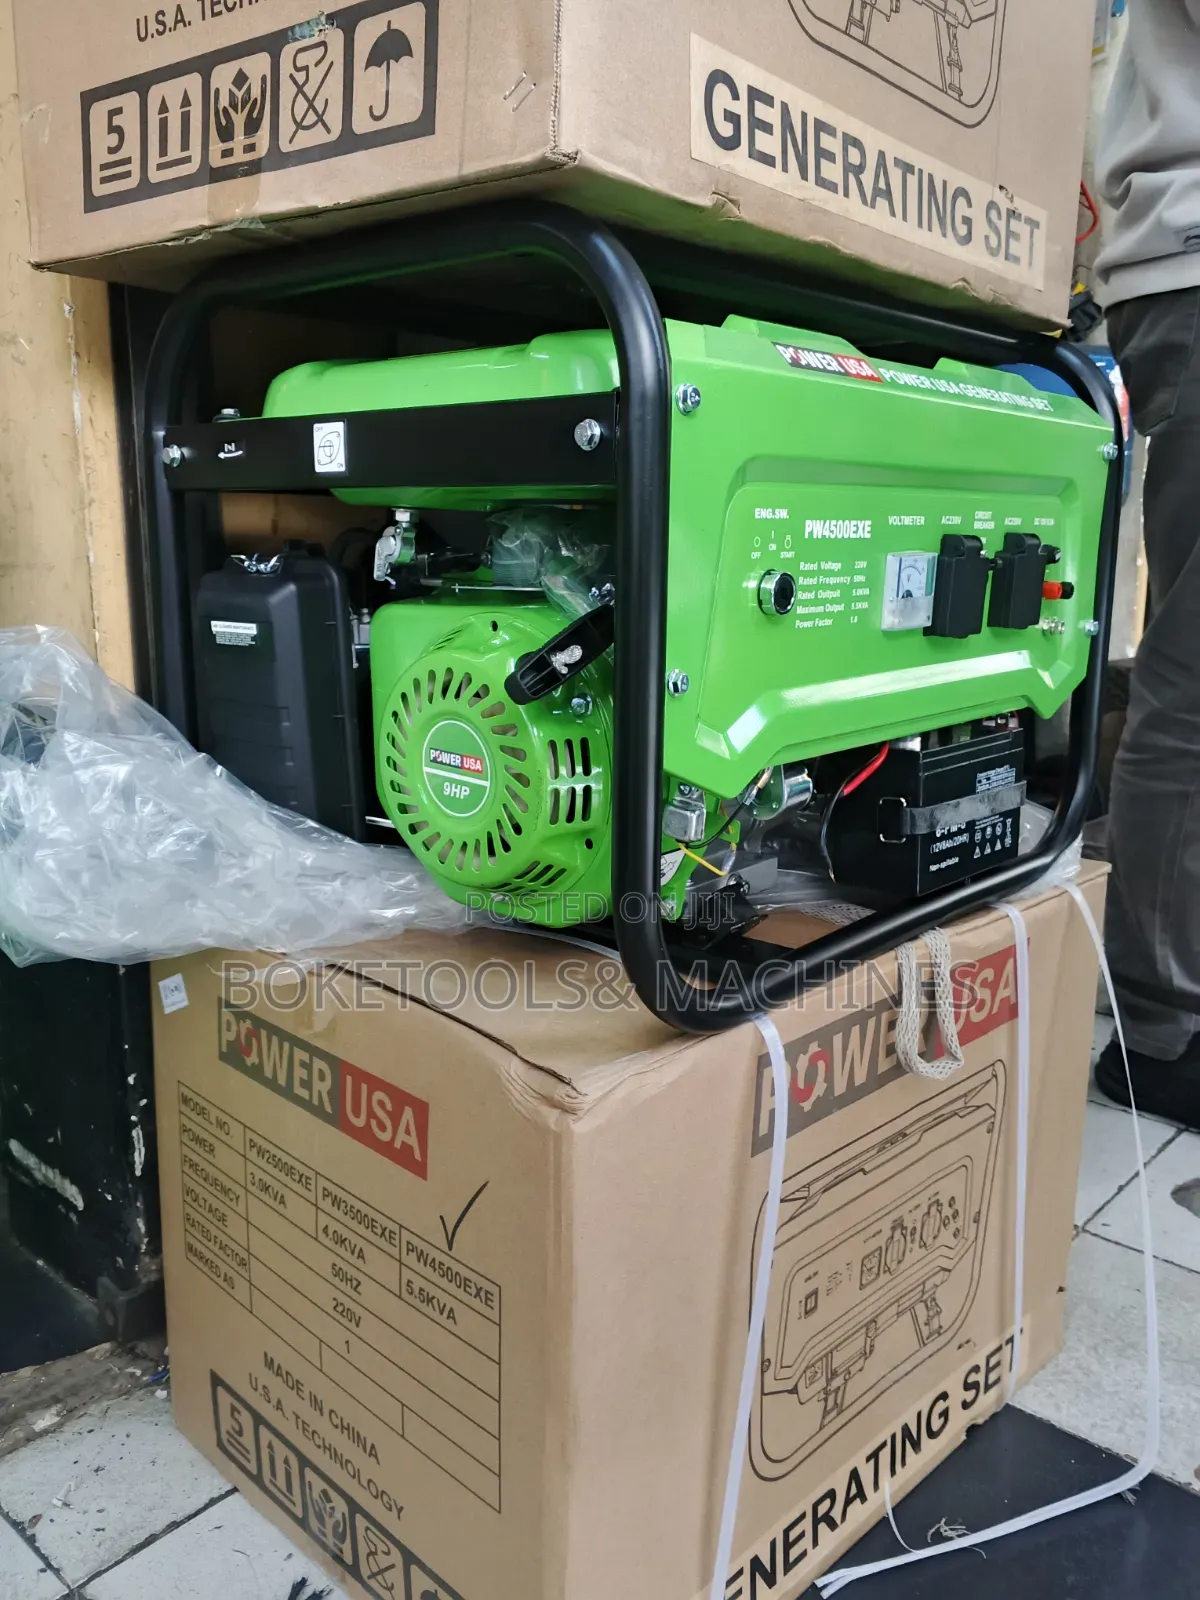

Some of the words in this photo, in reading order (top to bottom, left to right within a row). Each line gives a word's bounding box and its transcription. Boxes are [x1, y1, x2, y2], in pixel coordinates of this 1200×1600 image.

[136, 3, 192, 43] U.S.A.
[703, 68, 973, 247] GENERATING
[984, 199, 1041, 272] SET
[775, 344, 844, 374] POWER
[837, 356, 879, 378] USA
[878, 367, 937, 392] POWER
[932, 378, 963, 395] USA
[959, 383, 1035, 409] GENERATING
[1031, 398, 1054, 413] SET
[754, 508, 790, 519] ENG.SW.
[804, 519, 872, 539] PW4500EXE
[888, 515, 925, 526] VOLTMETER
[780, 551, 796, 559] START
[799, 561, 818, 571] Rated
[820, 561, 842, 572] Voltage
[797, 590, 815, 600] Rated
[798, 575, 818, 585] Rated
[819, 575, 851, 585] Frequency
[795, 620, 814, 629] Power
[815, 618, 834, 627] Factor
[796, 604, 824, 614] Maximum
[825, 603, 845, 613] Output
[430, 749, 462, 767] POWER
[463, 756, 483, 772] USA
[443, 782, 471, 800] 9HP
[220, 1008, 335, 1115] POWER
[344, 1074, 423, 1162] USA
[181, 1091, 214, 1126] MODEL
[215, 1115, 234, 1139] NO.
[248, 1137, 313, 1193] PW2500EXE
[321, 1185, 398, 1249] PW3500EXE
[405, 1239, 496, 1311] PW4500EXE
[181, 1123, 216, 1159] POWER
[249, 1171, 288, 1210] 3.0KVA
[321, 1223, 367, 1265] 4.0KVA
[405, 1278, 458, 1327] 5.5KVA
[183, 1154, 240, 1208] FREQUENCY
[330, 1262, 363, 1296] 50HZ
[184, 1182, 229, 1229] VOLTAGE
[331, 1297, 362, 1329] 220V
[187, 1241, 221, 1279] MARKED
[222, 1271, 235, 1290] AS
[185, 1212, 212, 1243] RATED
[213, 1234, 248, 1273] FACTOR
[344, 1339, 351, 1354] 1
[263, 1350, 306, 1402] MADE
[308, 1390, 324, 1417] IN
[328, 1408, 381, 1466] CHINA
[248, 1371, 289, 1421] U.S.A.
[292, 1410, 405, 1522] TECHNOLOGY
